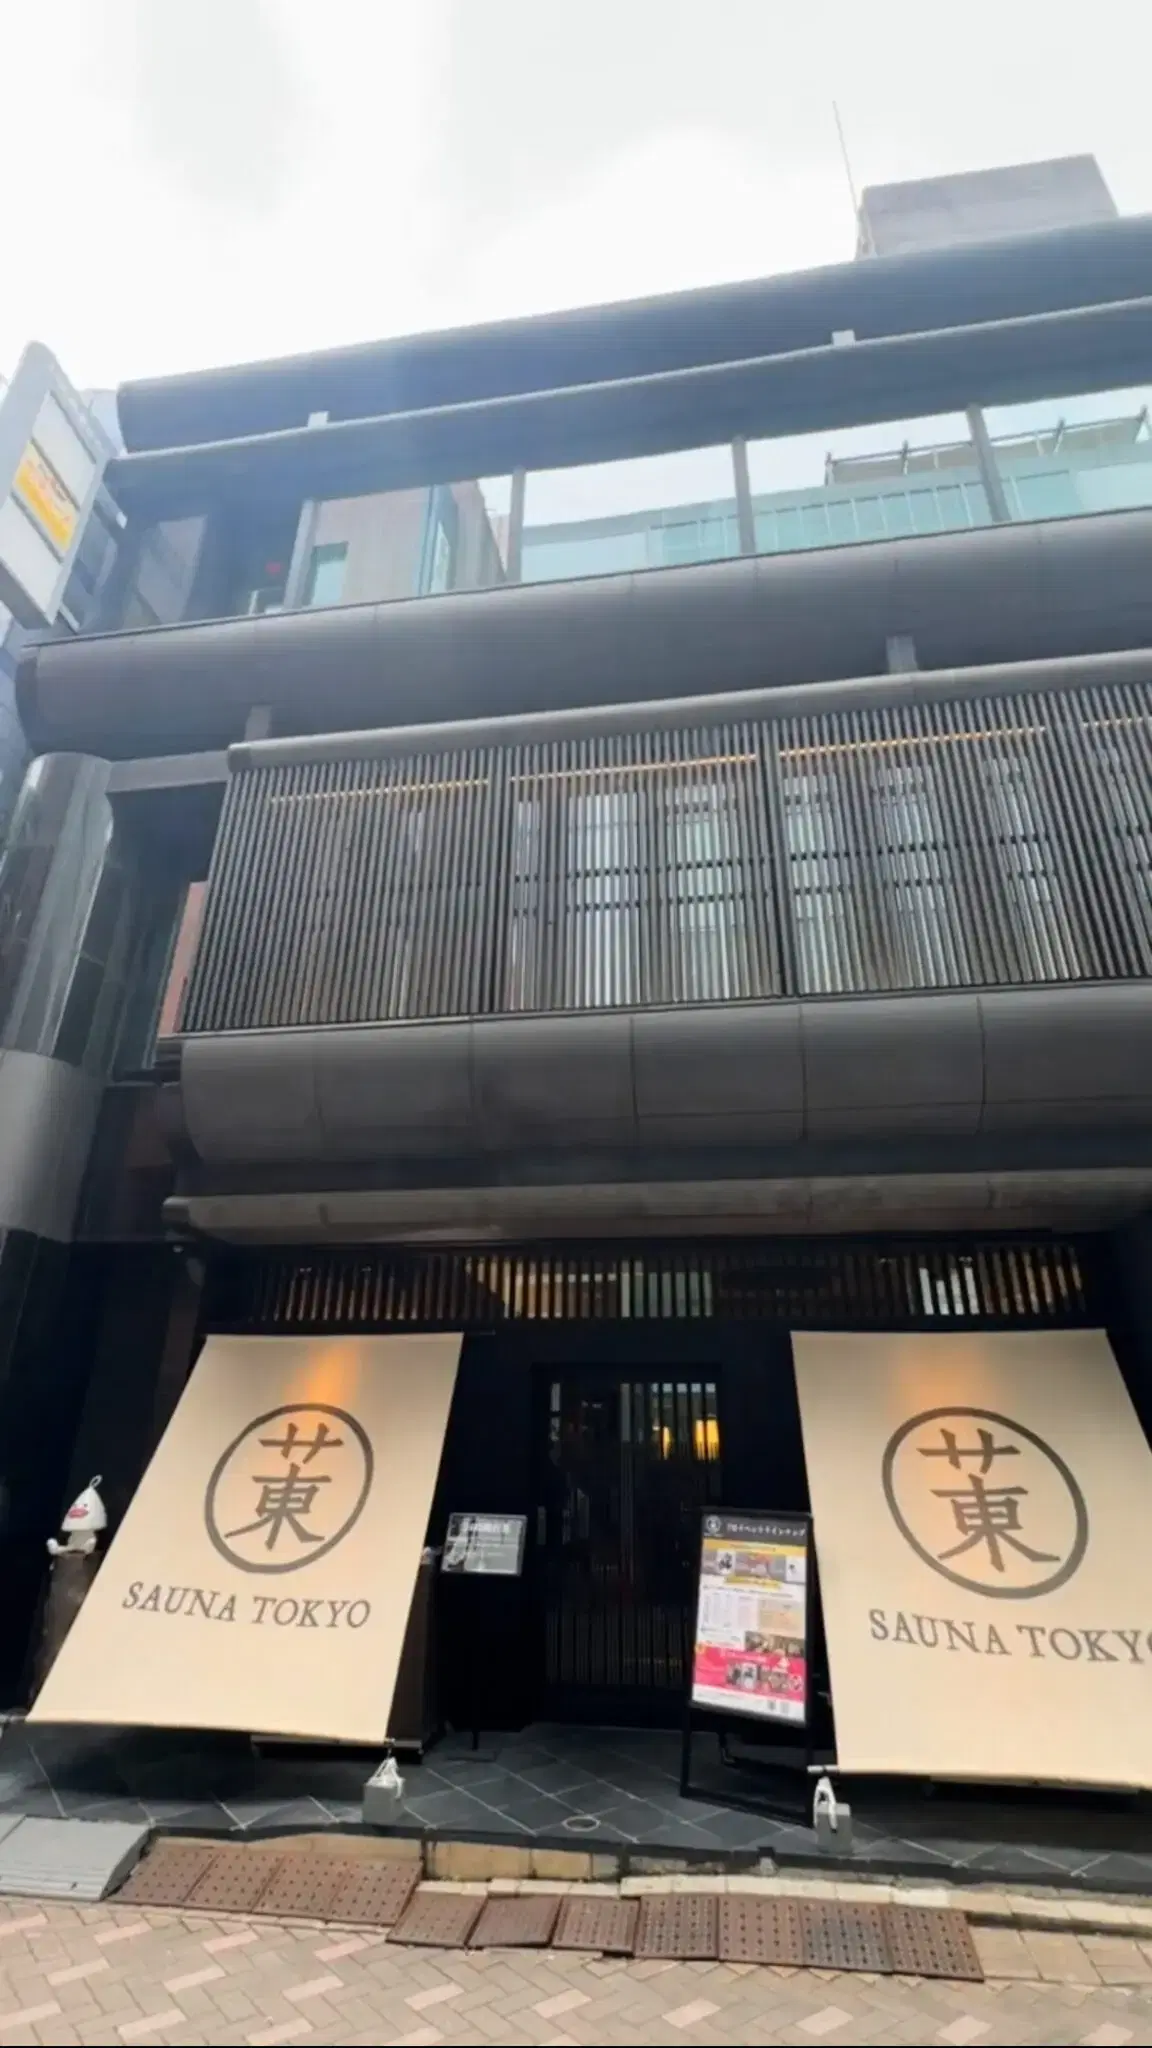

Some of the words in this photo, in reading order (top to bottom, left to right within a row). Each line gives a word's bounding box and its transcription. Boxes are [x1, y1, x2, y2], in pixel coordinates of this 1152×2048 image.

[121, 1580, 237, 1622] SAUNA
[250, 1595, 372, 1629] TOKYO
[868, 1607, 1013, 1656] SAUNA
[1015, 1623, 1152, 1665] TOKY
